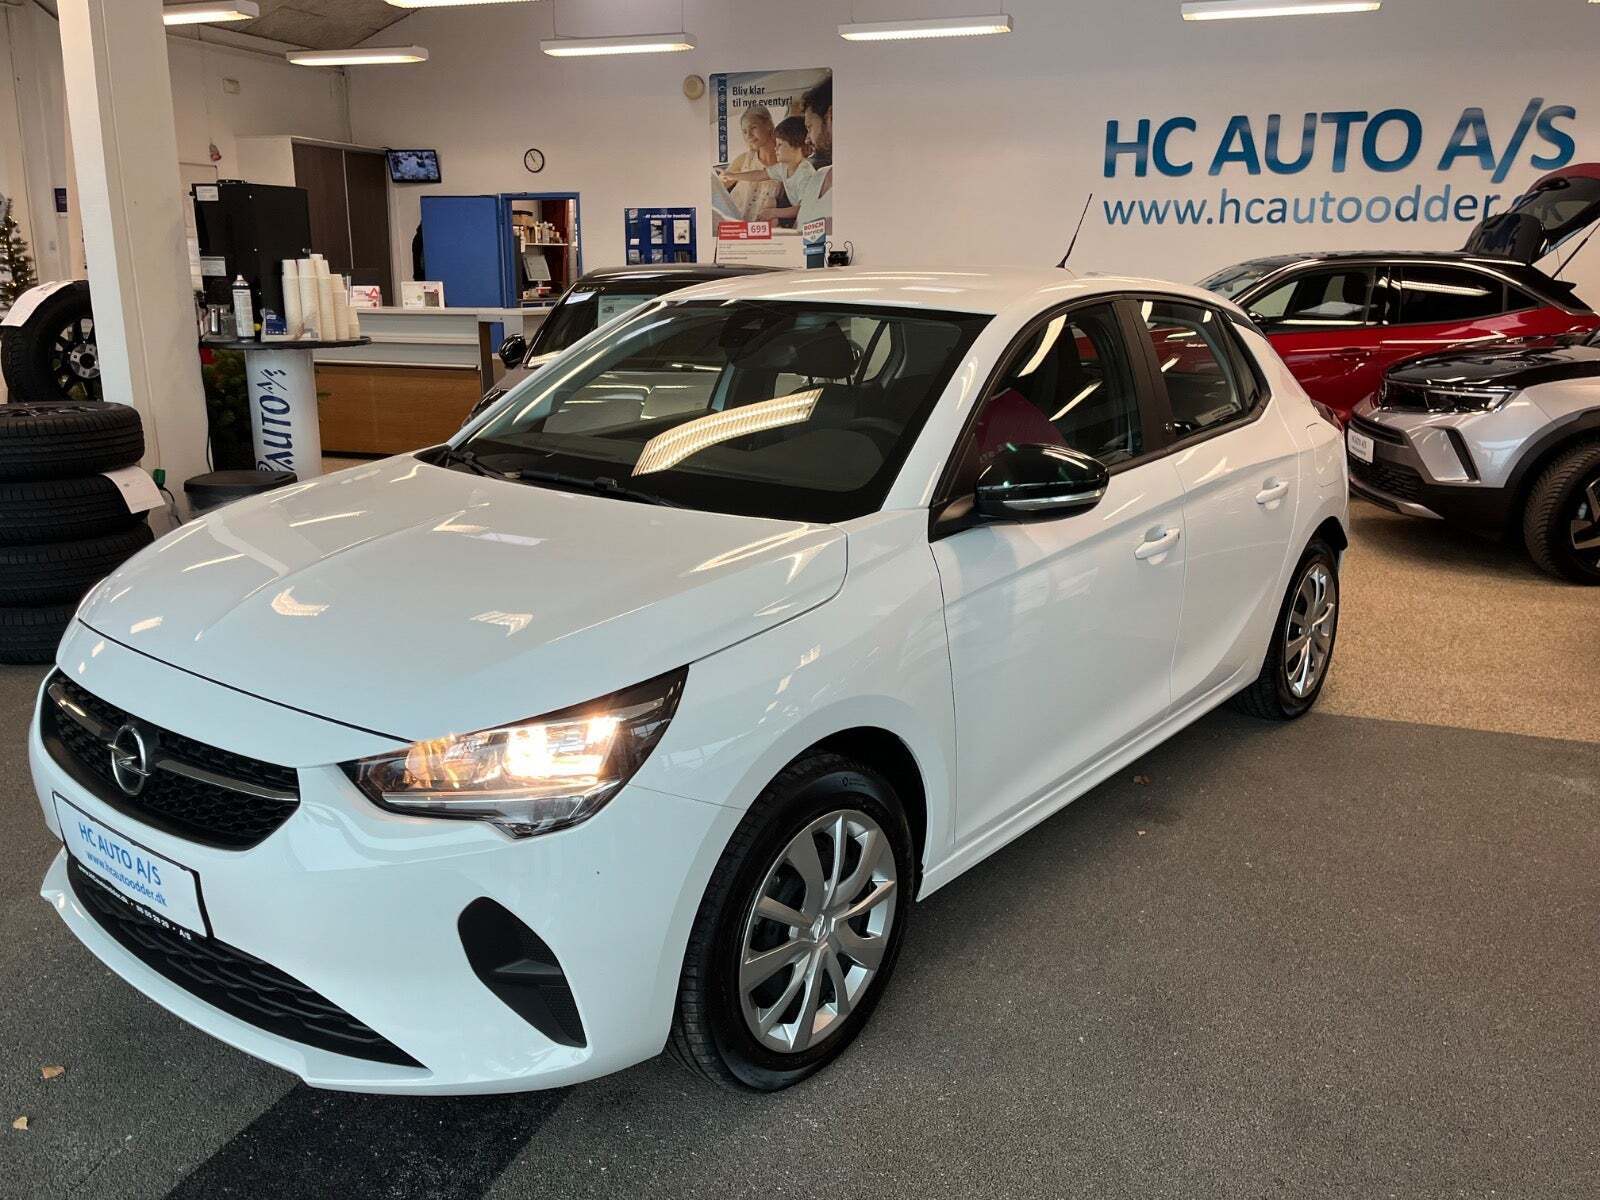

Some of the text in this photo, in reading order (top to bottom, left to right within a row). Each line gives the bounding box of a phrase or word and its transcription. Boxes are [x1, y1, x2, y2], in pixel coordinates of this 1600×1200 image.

[732, 84, 765, 96] Bliv klar
[732, 96, 793, 108] til nye eventyr!
[1103, 97, 1577, 184] HC AUTO A/S
[751, 224, 767, 233] 699
[803, 221, 824, 230] BOSCH
[259, 394, 295, 471] AUTO
[78, 822, 97, 848] HC
[97, 835, 132, 870] AUTO
[136, 857, 162, 886] A/S
[87, 852, 168, 907] www.hcautoodder.dk
